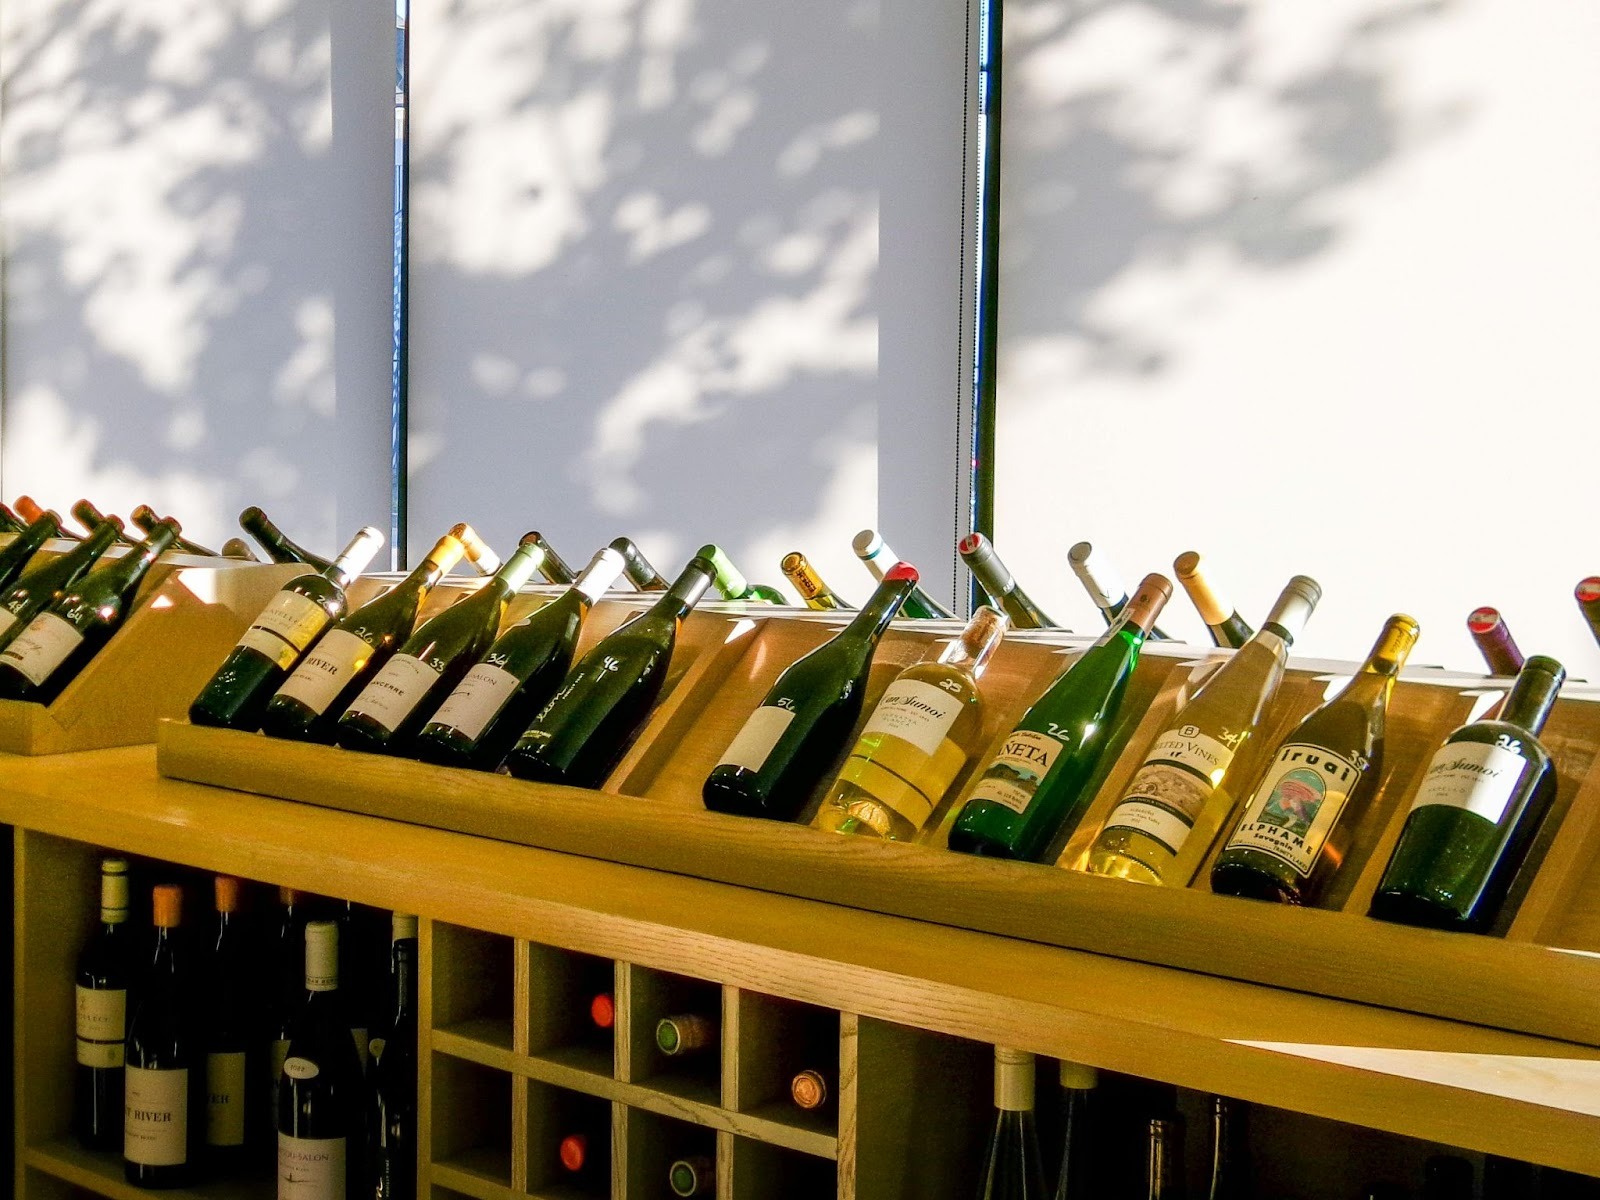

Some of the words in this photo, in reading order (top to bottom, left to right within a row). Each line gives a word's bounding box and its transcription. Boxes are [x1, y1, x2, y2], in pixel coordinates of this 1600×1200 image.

[355, 626, 373, 644] 26
[306, 657, 338, 676] RIVER
[430, 657, 445, 672] 33
[603, 655, 619, 671] 46
[1047, 722, 1070, 742] 26
[1187, 741, 1220, 766] VINES
[1496, 734, 1522, 755] 26
[1281, 749, 1351, 782] Iruai
[1240, 823, 1313, 855] ELPHAME
[134, 1109, 171, 1123] RIVER
